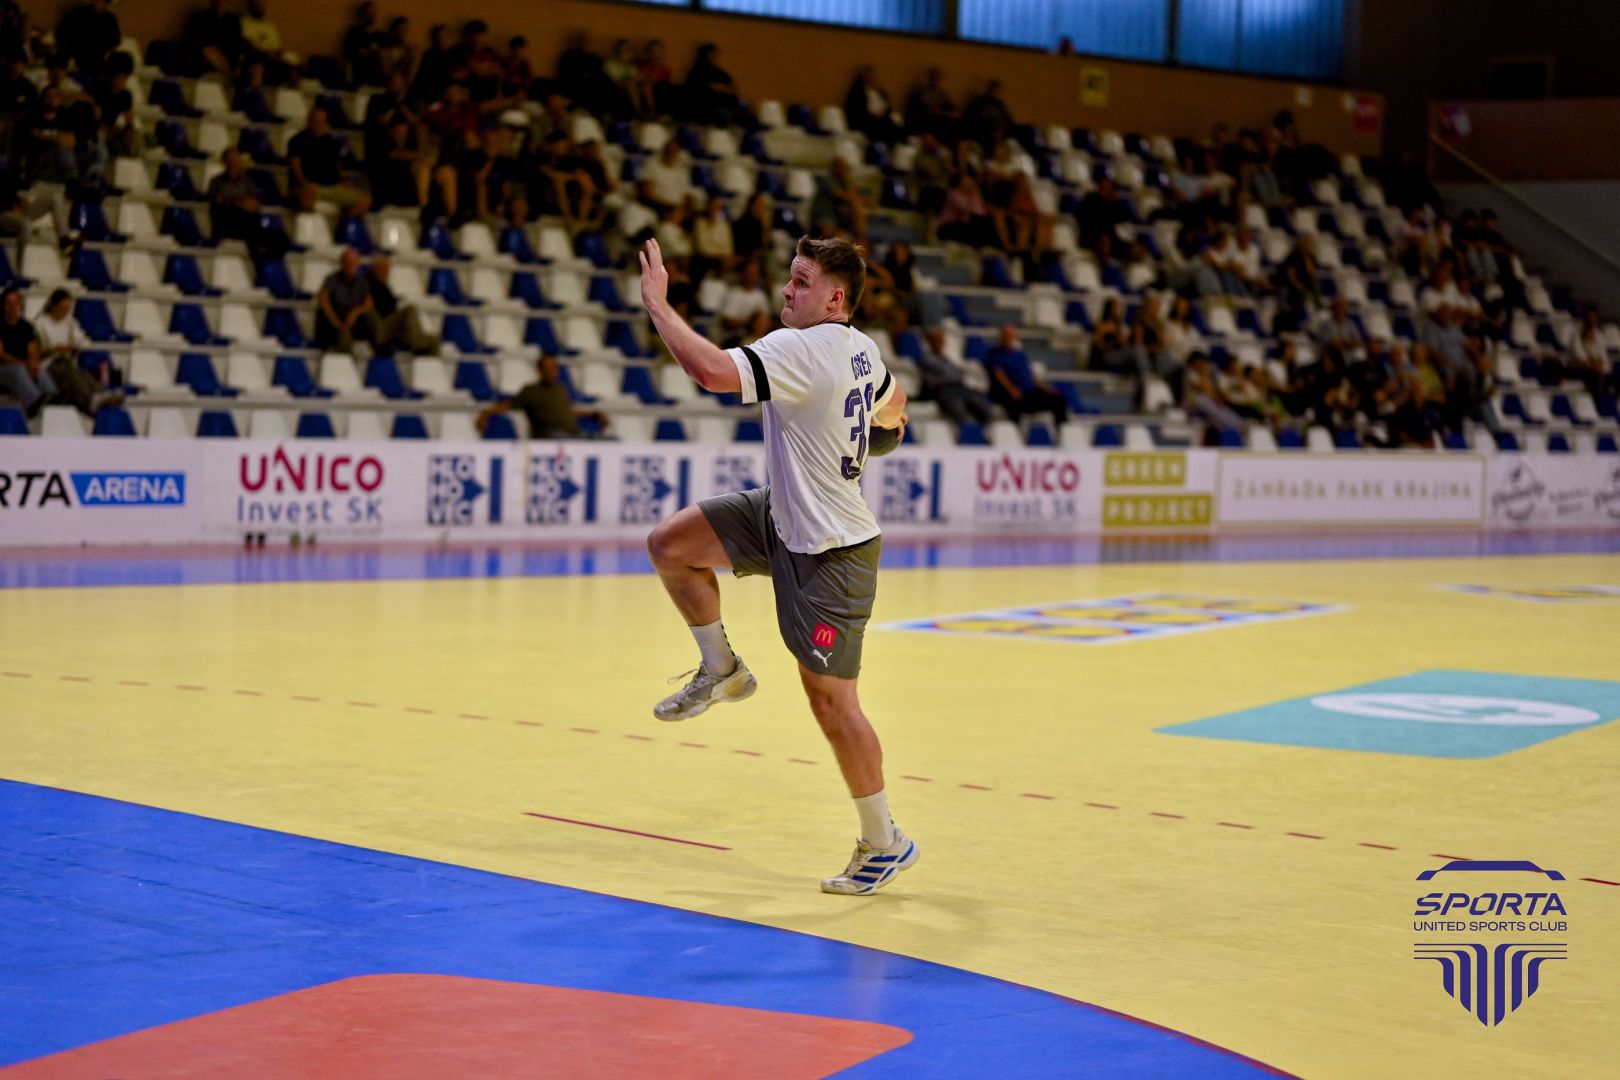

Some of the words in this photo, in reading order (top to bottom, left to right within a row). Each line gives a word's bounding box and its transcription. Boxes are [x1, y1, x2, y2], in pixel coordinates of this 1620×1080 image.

[240, 445, 384, 494] UNICO
[976, 454, 1080, 492] UNICO
[84, 476, 180, 502] ARENA
[238, 496, 332, 523] Invest
[346, 496, 383, 523] SK
